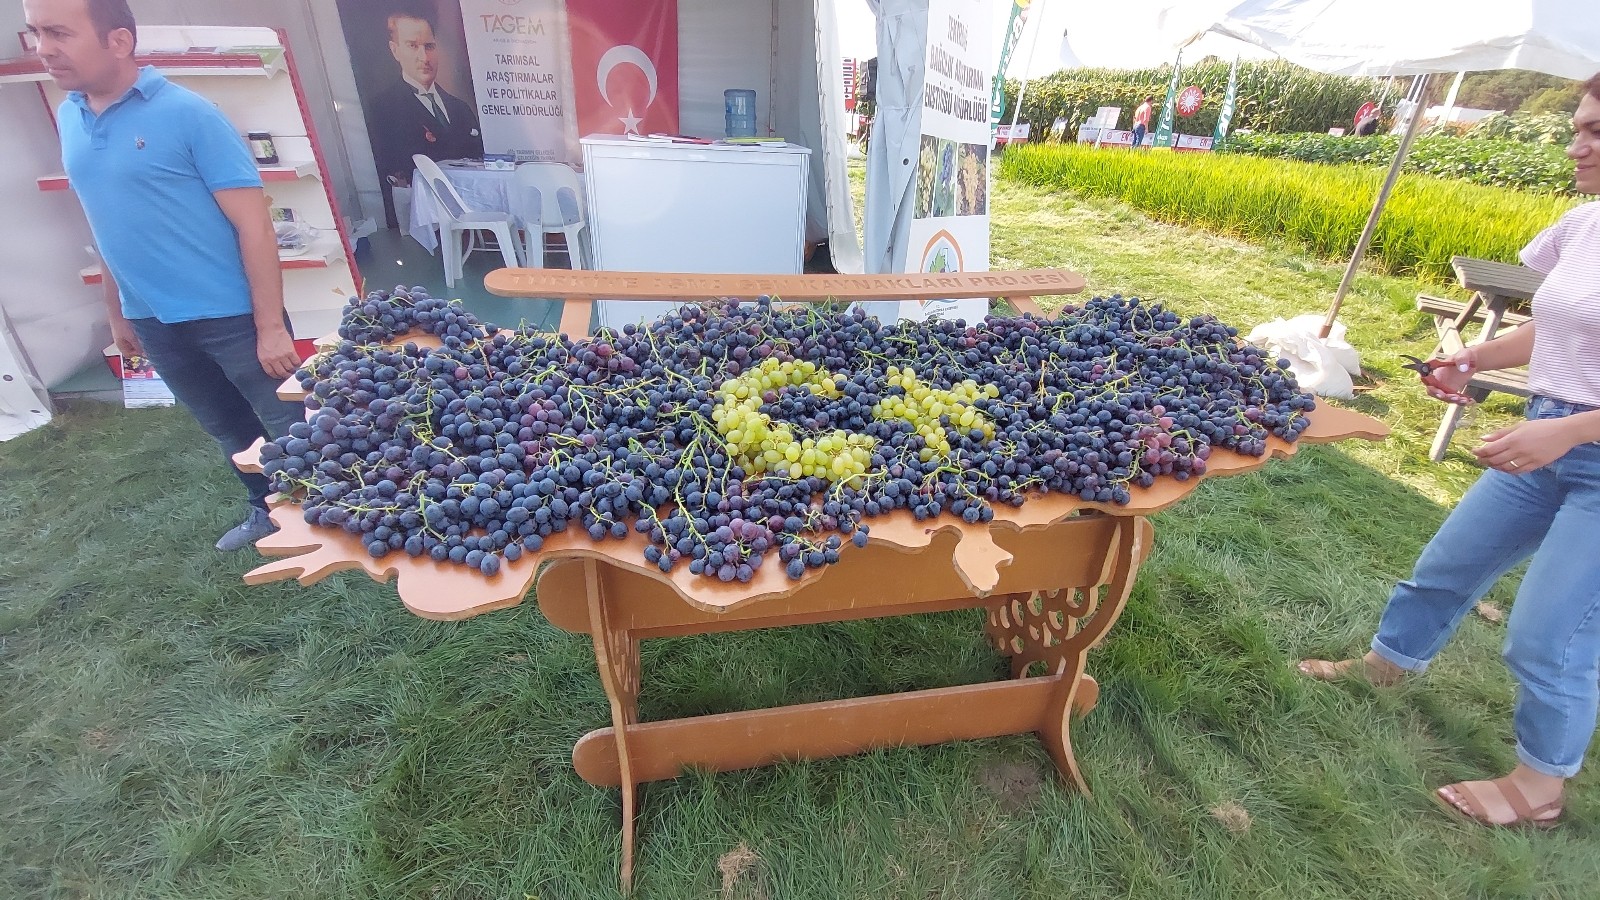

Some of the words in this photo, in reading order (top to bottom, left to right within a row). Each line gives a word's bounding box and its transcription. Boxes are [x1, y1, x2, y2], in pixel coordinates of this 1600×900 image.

[479, 14, 545, 36] TAGEM
[495, 54, 540, 67] TARIMSAL
[486, 71, 554, 84] ARAŞTIRMALAR
[486, 88, 499, 99] VE
[501, 87, 557, 101] POLİTİKALAR
[481, 104, 511, 116] GENEL
[799, 277, 963, 291] KAYNAKLARI
[967, 272, 1070, 287] PROJESİ
